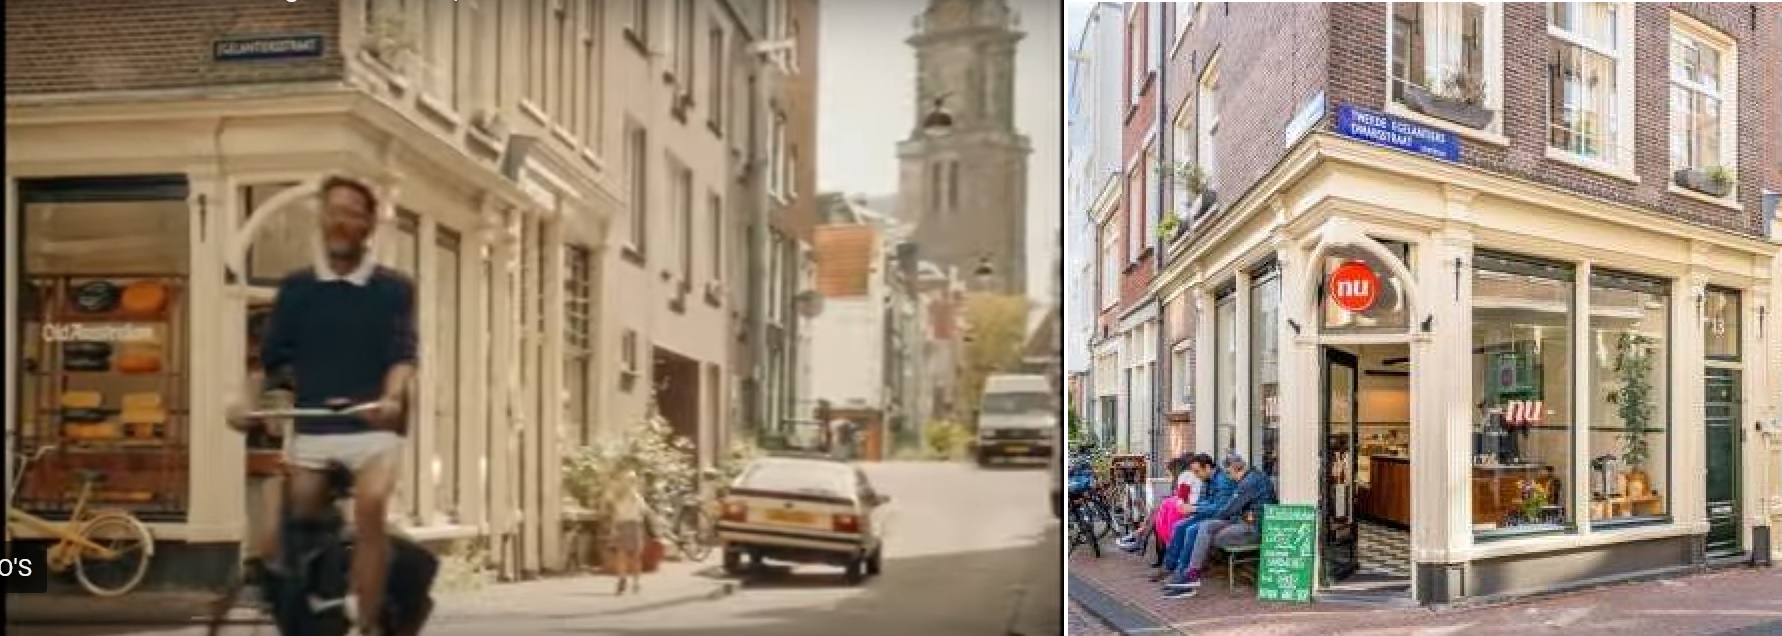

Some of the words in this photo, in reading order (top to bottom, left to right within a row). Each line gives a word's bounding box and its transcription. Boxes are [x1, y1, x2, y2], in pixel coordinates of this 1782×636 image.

[1337, 280, 1369, 297] nu
[42, 323, 69, 342] Old
[1506, 399, 1543, 422] nu
